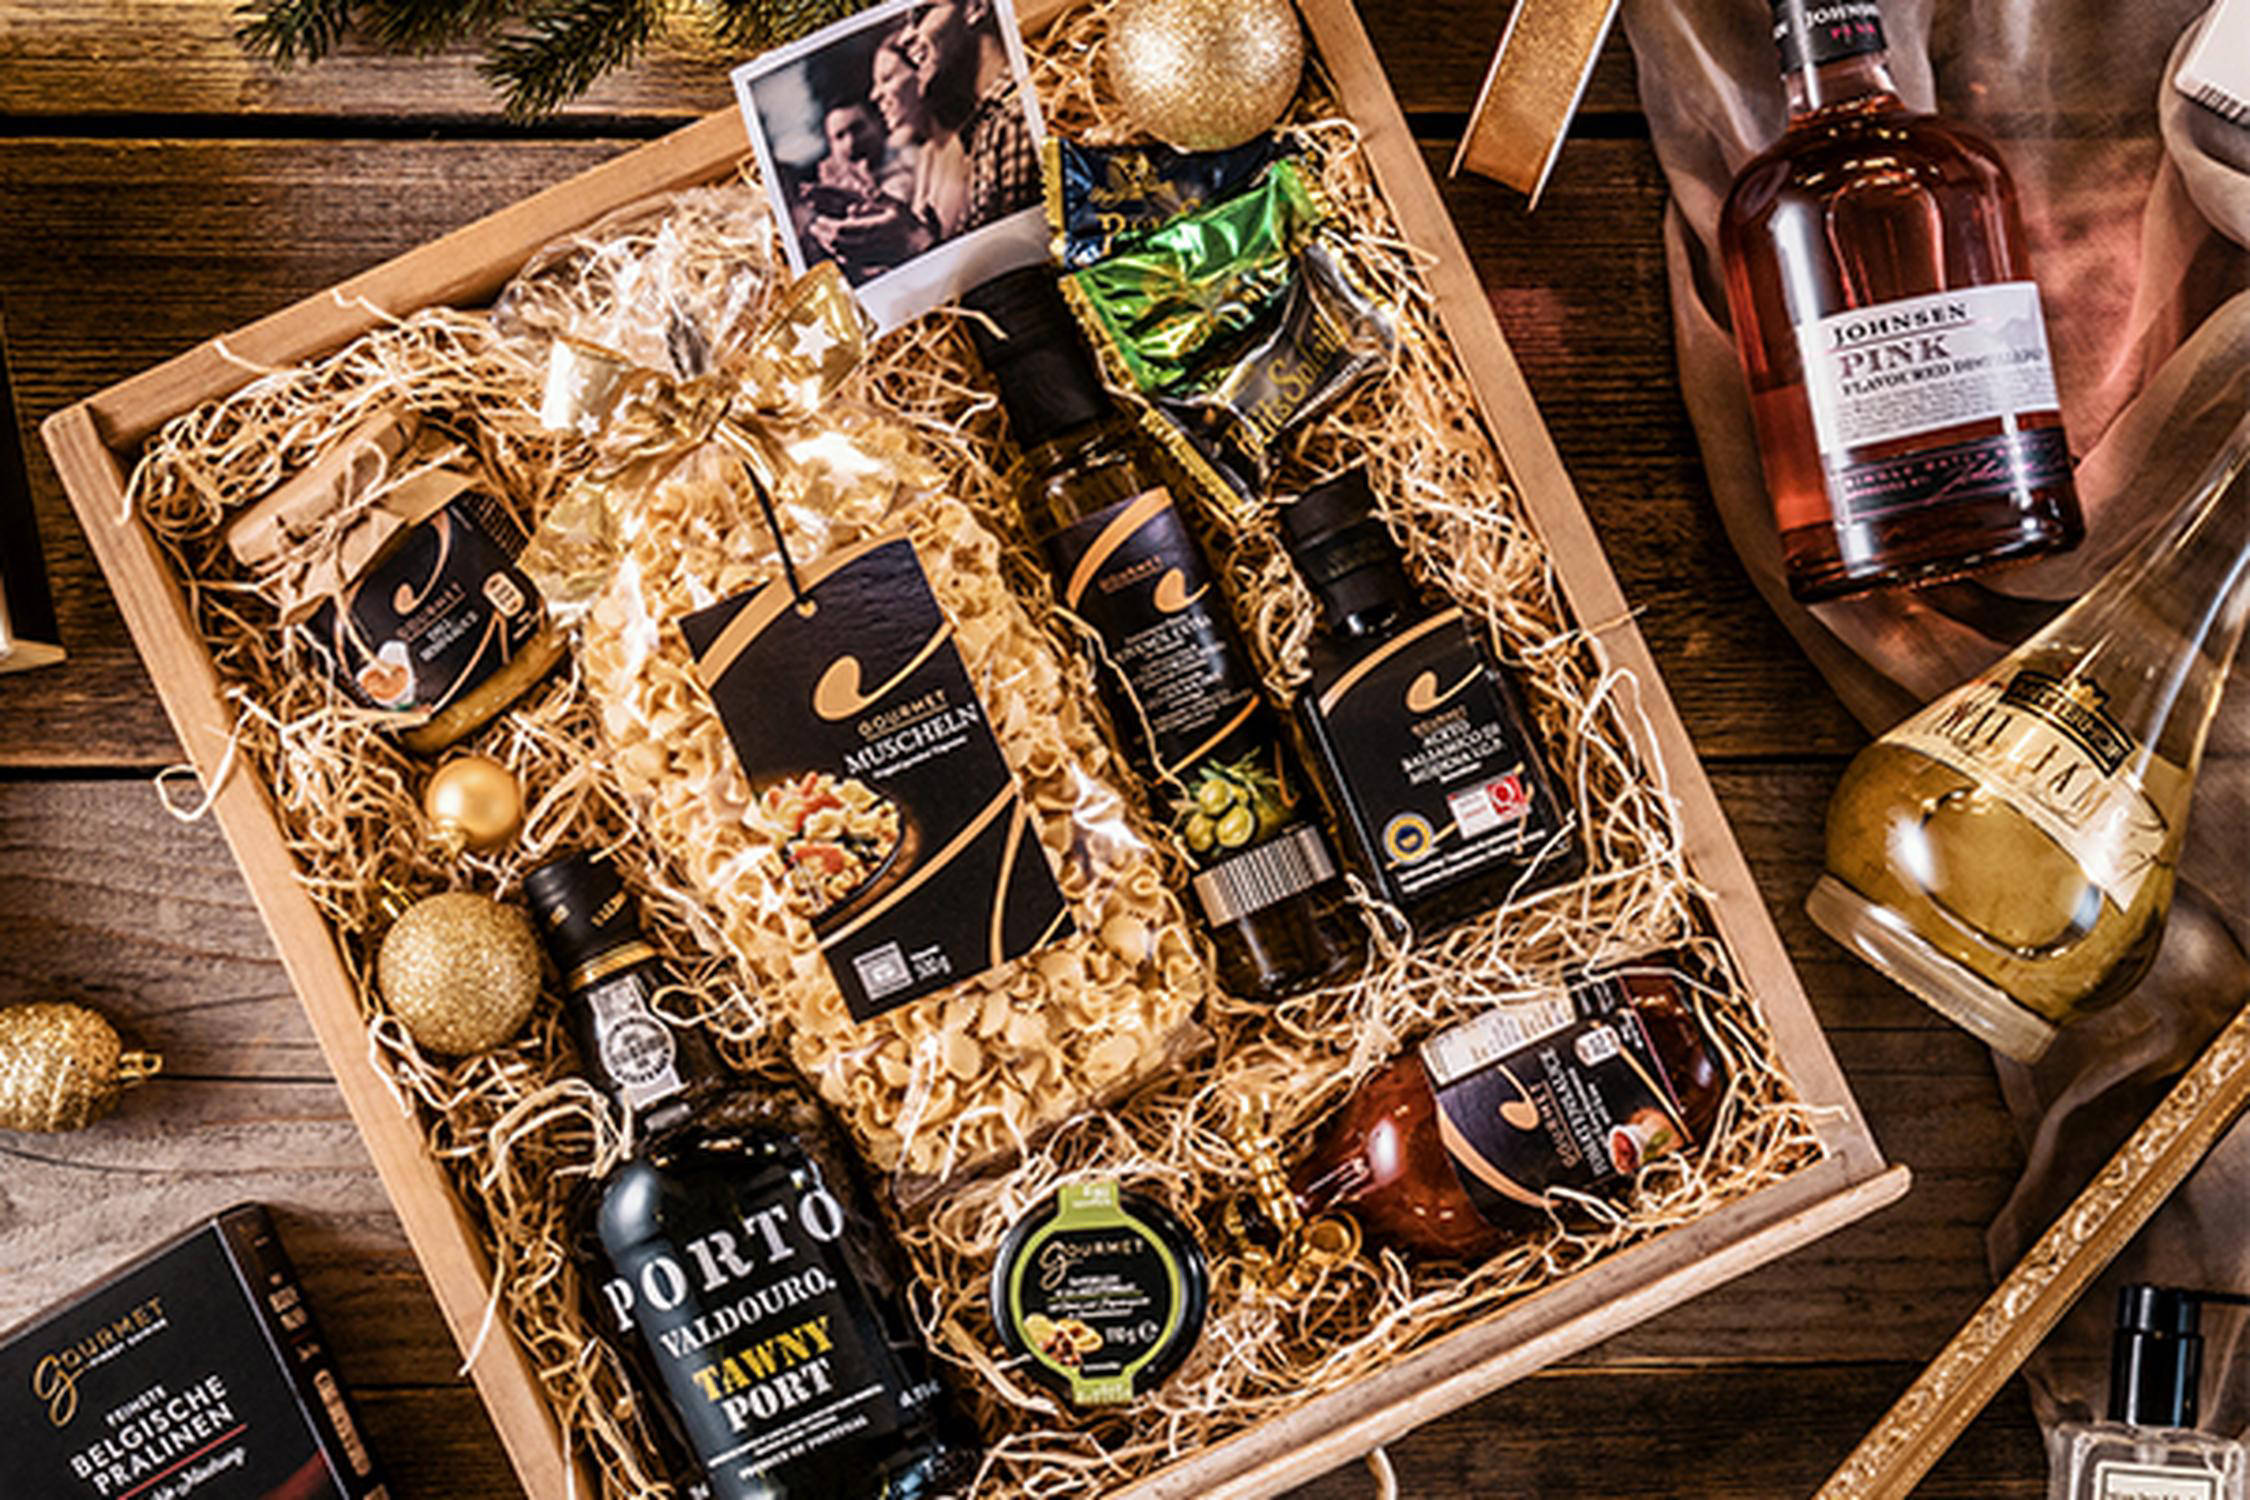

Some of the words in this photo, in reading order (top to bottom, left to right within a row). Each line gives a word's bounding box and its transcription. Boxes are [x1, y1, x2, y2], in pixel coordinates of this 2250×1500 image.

[1833, 302, 1967, 346] JOHNSEN
[1840, 334, 1950, 378] PINK
[1841, 363, 1951, 397] FLAVOURED
[843, 703, 981, 776] MUSCHELN
[603, 1187, 844, 1332] PORTO
[659, 1265, 838, 1360] VALDOURO.
[32, 1296, 164, 1428] GOURMET
[692, 1315, 834, 1402] TAWNY
[720, 1356, 833, 1433] PORT
[70, 1373, 228, 1479] BELGISCHE
[93, 1401, 235, 1496] PRALINEN
